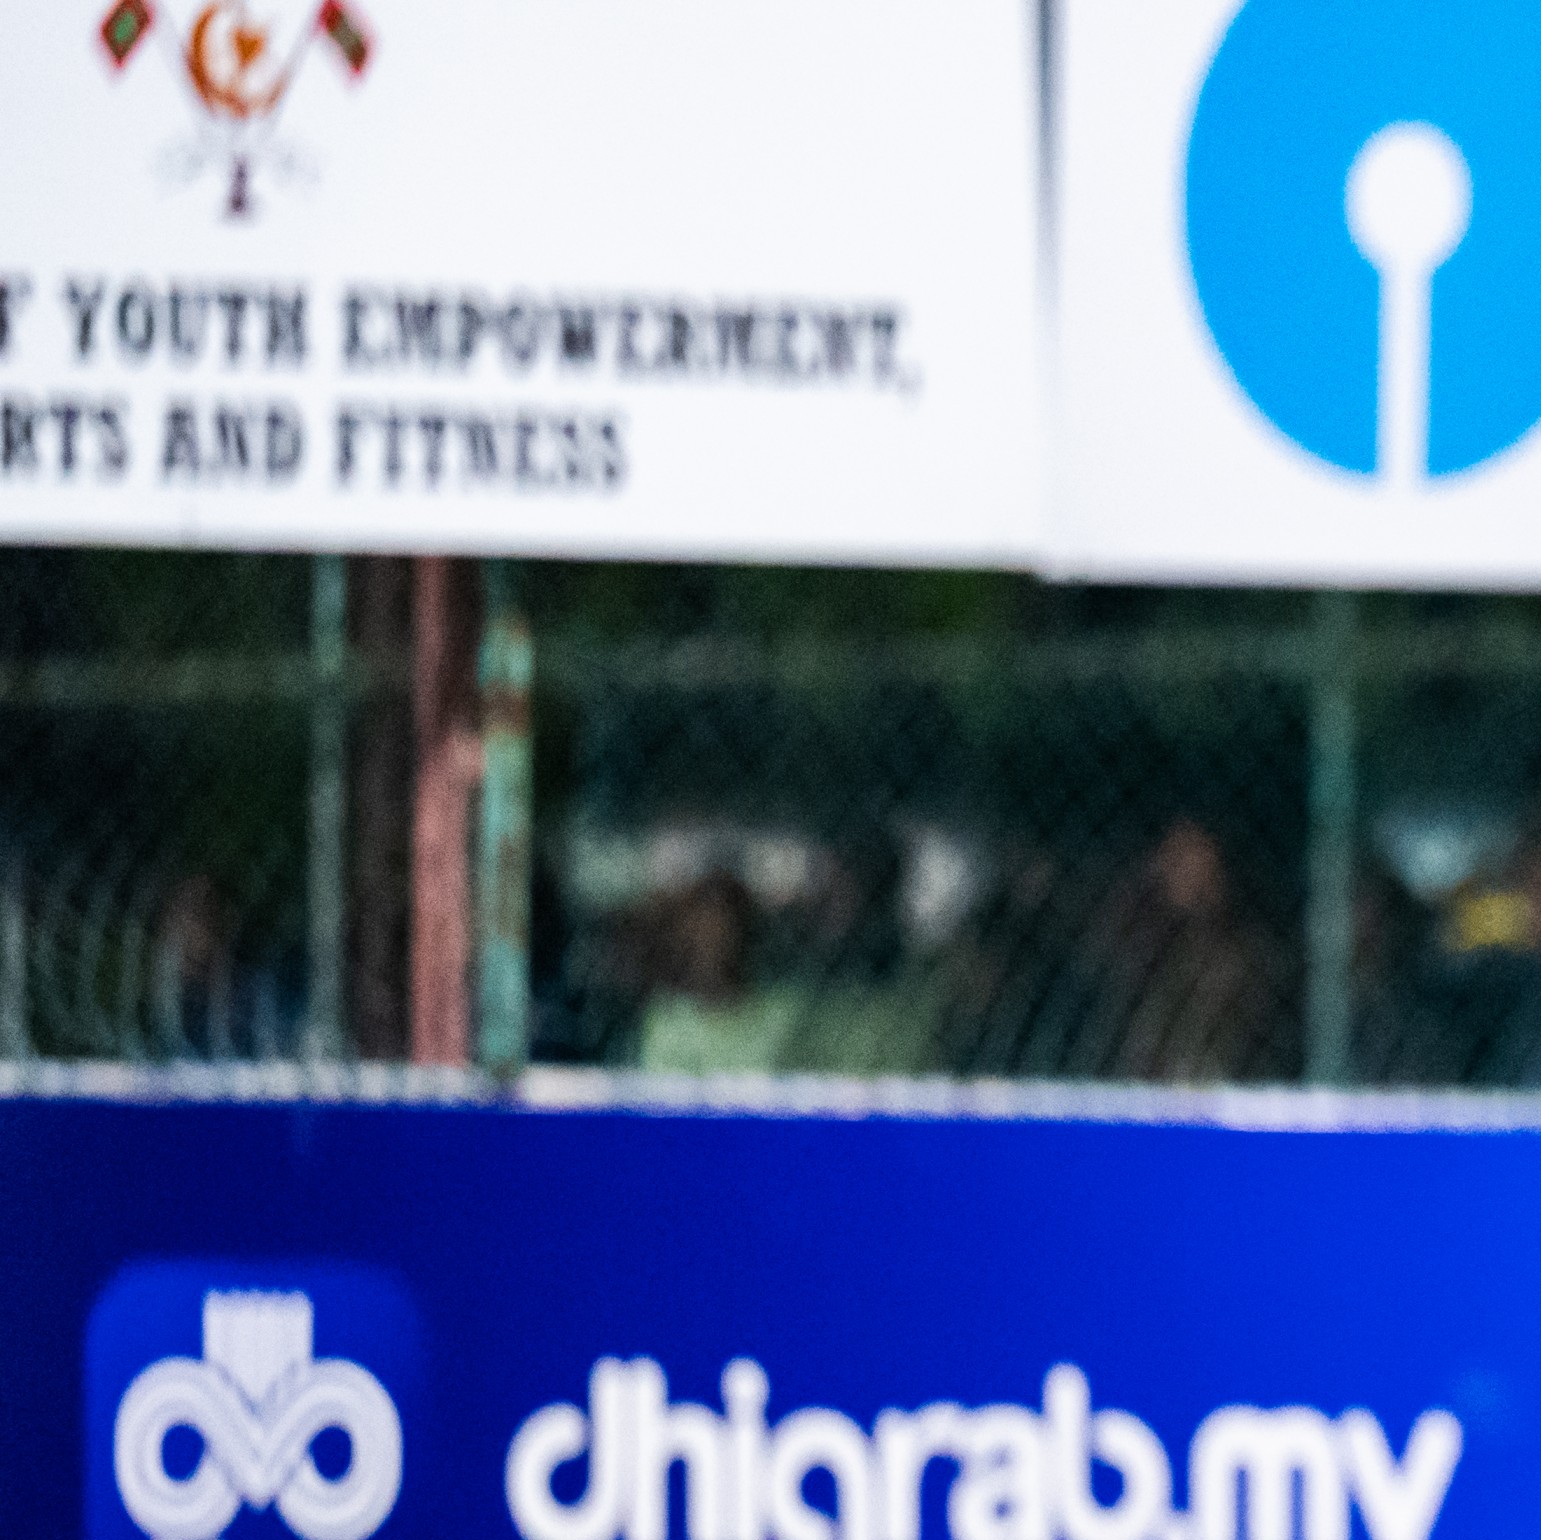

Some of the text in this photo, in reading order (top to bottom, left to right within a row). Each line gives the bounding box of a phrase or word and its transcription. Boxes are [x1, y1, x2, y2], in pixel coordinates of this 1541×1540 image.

[64, 275, 310, 364] YOUTH
[340, 280, 922, 400] EMPOWERMENT,
[158, 398, 308, 482] AND
[333, 404, 628, 496] FITNESS
